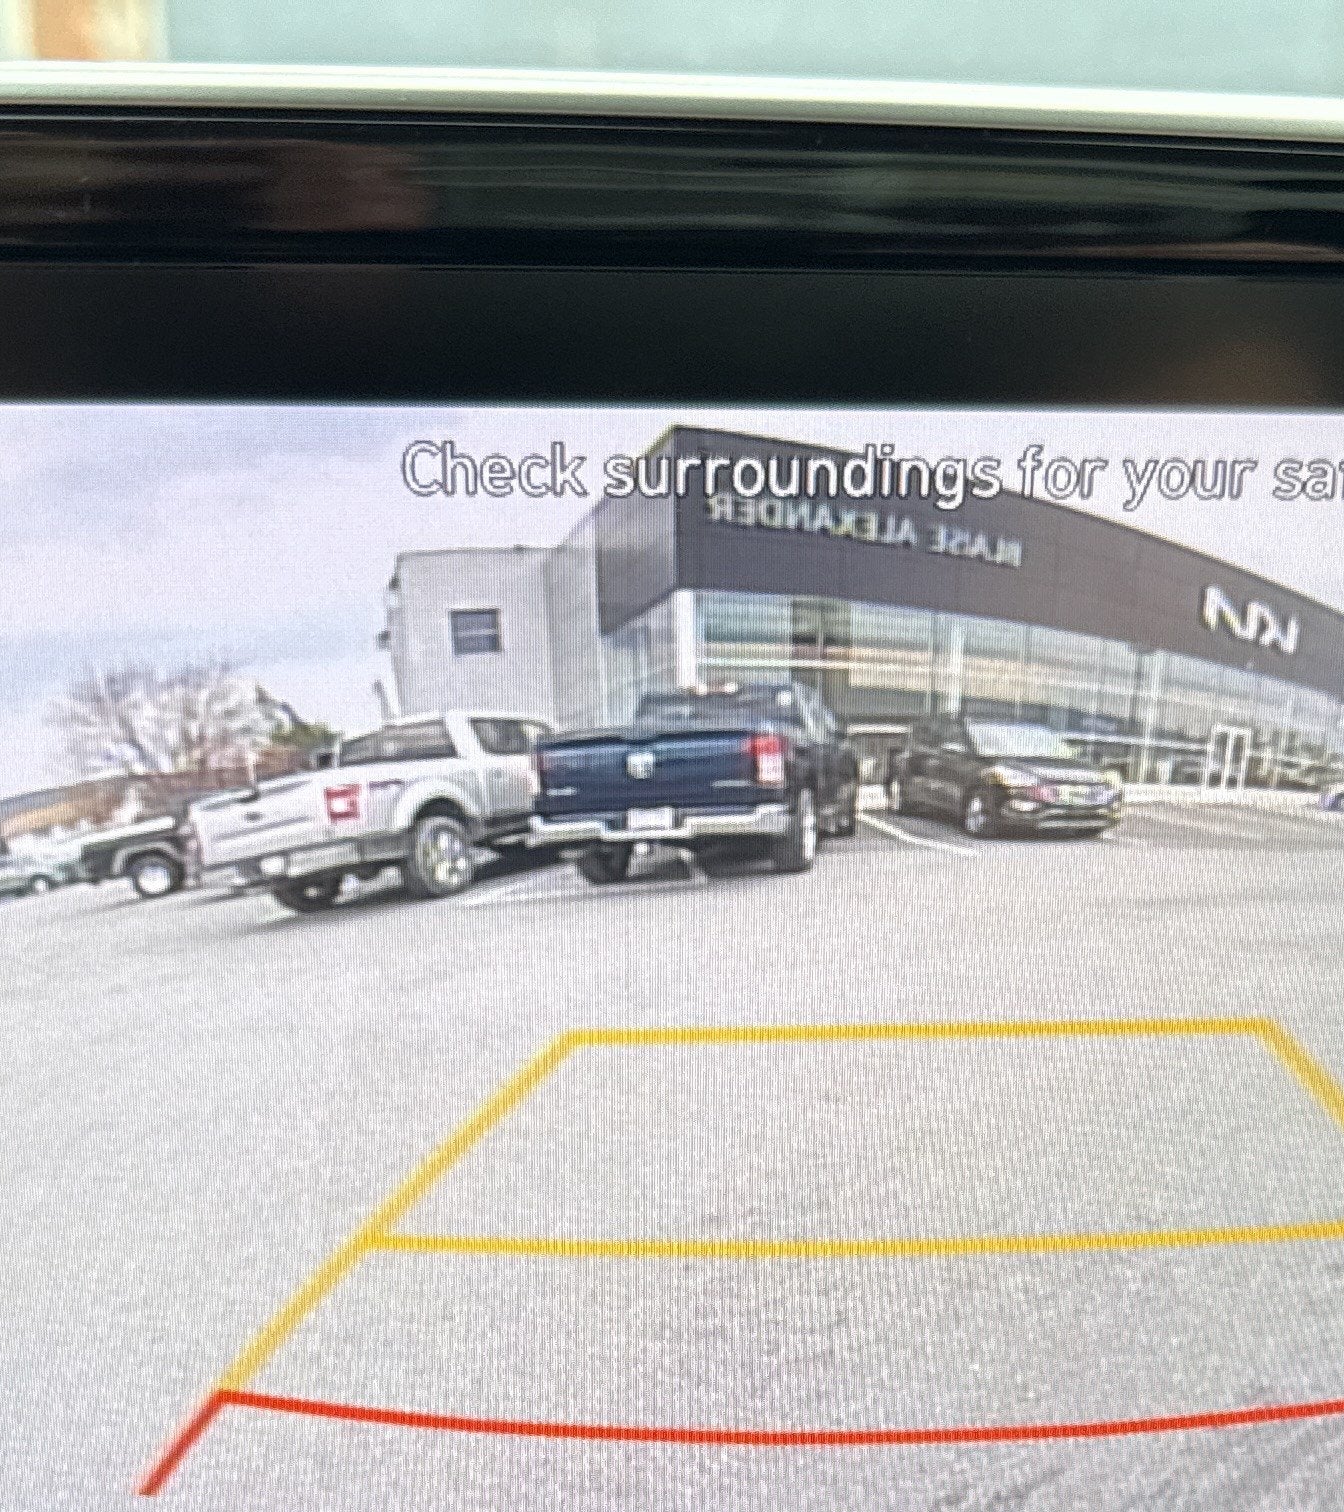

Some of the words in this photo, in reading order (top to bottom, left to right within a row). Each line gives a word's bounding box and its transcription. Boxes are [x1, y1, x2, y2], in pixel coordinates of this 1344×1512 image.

[400, 440, 590, 498] Check
[603, 443, 1003, 510] surroundings
[1017, 444, 1109, 500] for
[1122, 454, 1258, 513] your
